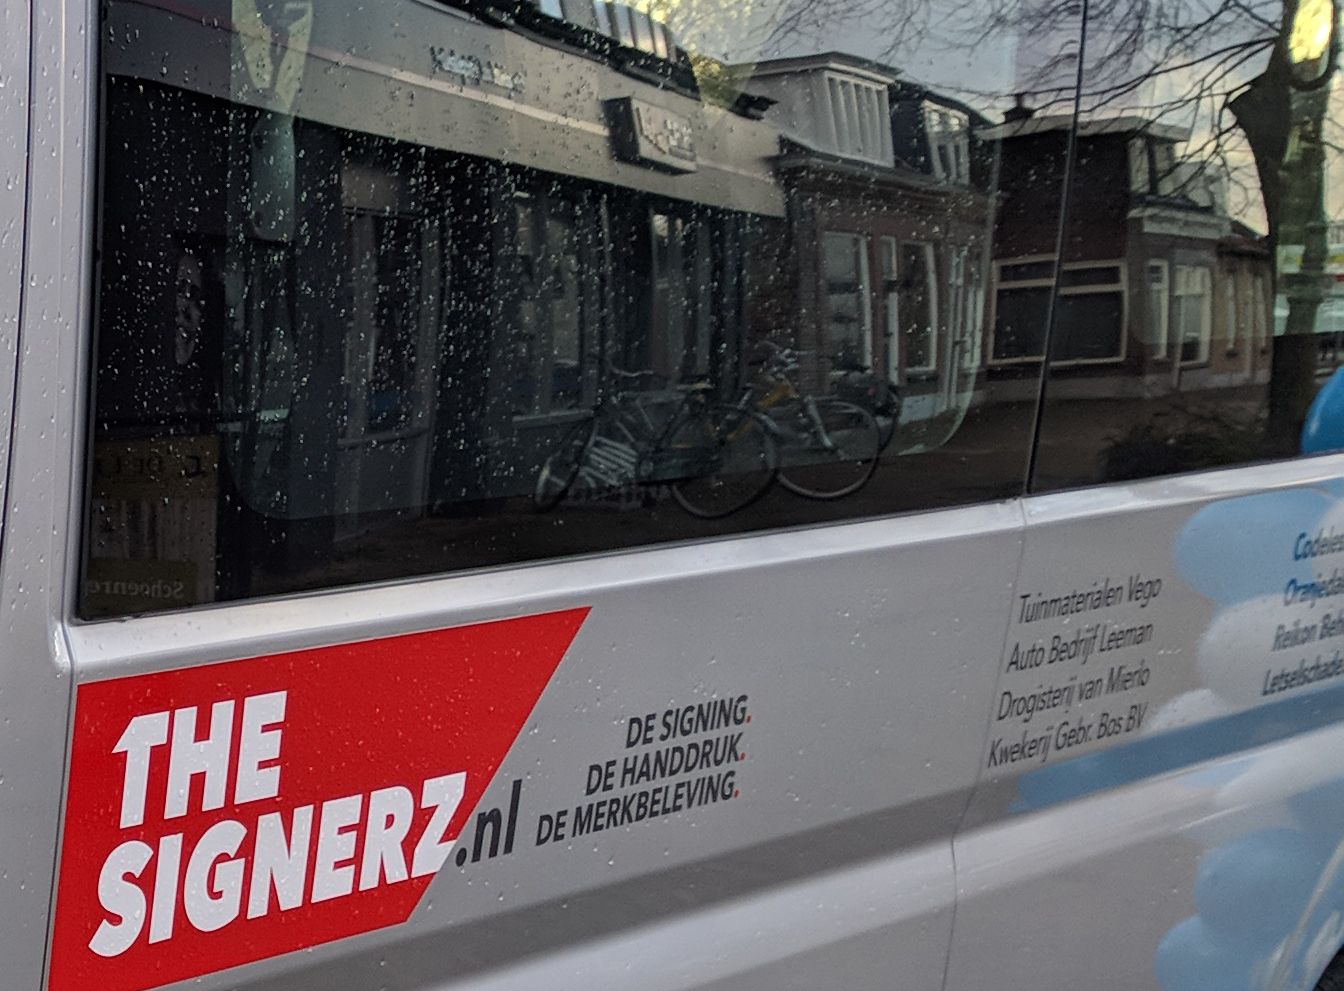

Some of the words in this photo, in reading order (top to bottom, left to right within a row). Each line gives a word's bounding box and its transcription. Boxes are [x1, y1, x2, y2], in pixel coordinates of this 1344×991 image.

[1019, 576, 1123, 624] Tuinmaterialen
[1127, 573, 1163, 608] Vego
[1006, 642, 1045, 673] Auto
[1047, 624, 1100, 665] Bedrijf
[1099, 624, 1154, 653] Leeman
[627, 715, 657, 750] DE
[659, 694, 752, 741] SIGNING.
[996, 676, 1078, 724] Drogisterij
[1078, 679, 1103, 702] van
[1104, 659, 1151, 695] Mierlo
[112, 690, 288, 830] THE
[585, 762, 618, 798] DE
[620, 733, 746, 791] HANDDRUK.
[988, 725, 1054, 769] Kwekerij
[1055, 716, 1093, 751] Gebr.
[1096, 712, 1123, 740] Bos
[1124, 702, 1149, 733] BV
[535, 812, 568, 847] DE
[570, 771, 741, 839] MERKBELEVING.
